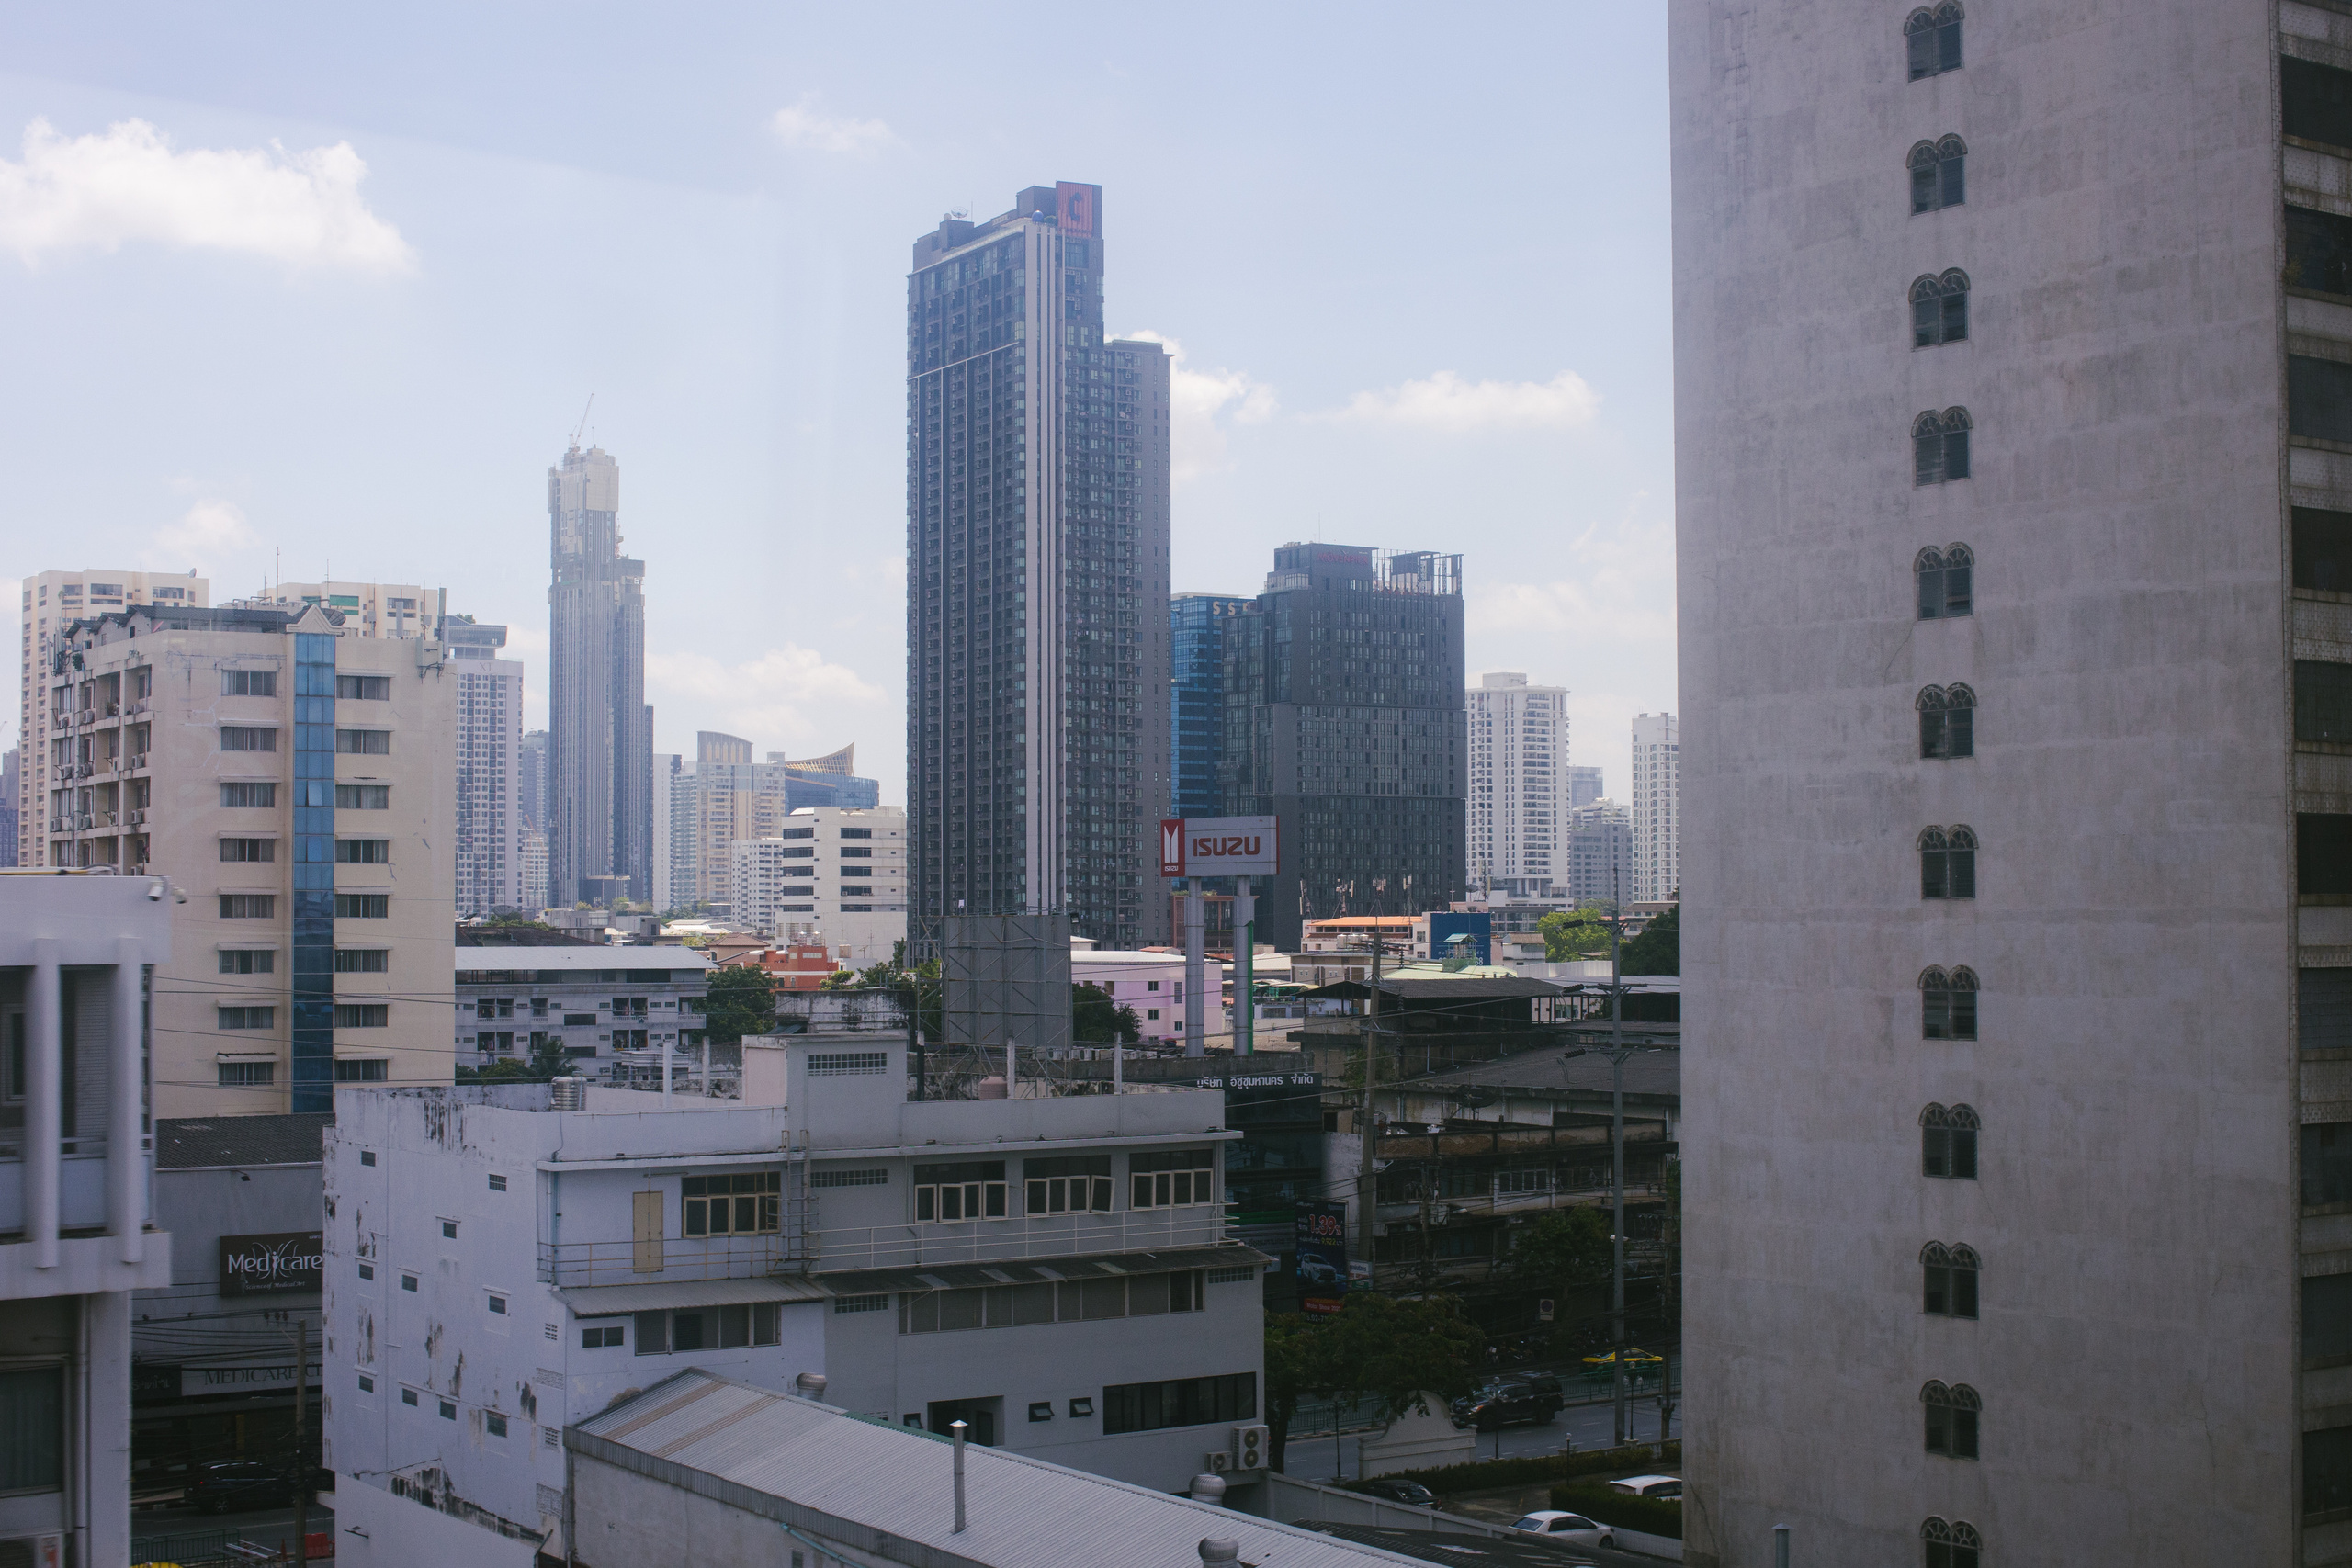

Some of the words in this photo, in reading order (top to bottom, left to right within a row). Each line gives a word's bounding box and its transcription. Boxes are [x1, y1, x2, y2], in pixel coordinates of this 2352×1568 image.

[1193, 836, 1260, 856] ISUZU
[1197, 1076, 1223, 1088] บริษัท
[1290, 1073, 1314, 1085] จำกัด
[227, 1250, 322, 1275] Medicare
[204, 1366, 298, 1385] MEDICARE
